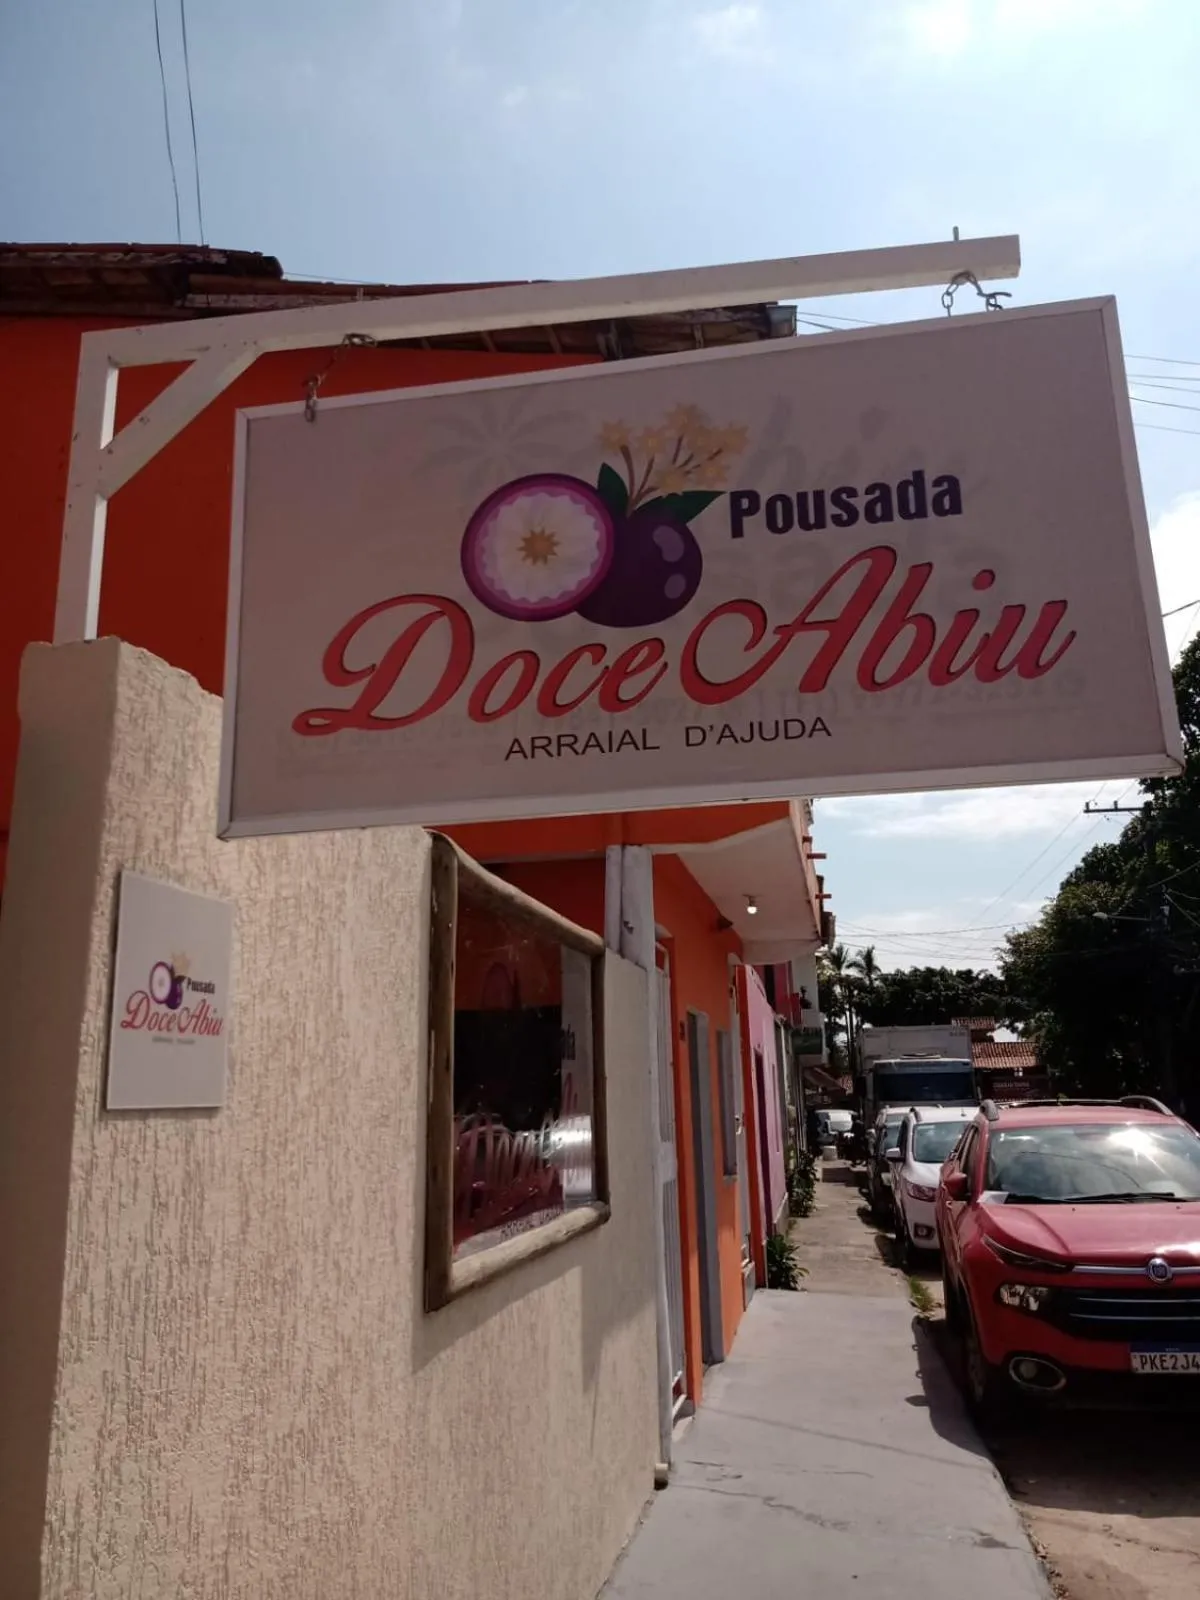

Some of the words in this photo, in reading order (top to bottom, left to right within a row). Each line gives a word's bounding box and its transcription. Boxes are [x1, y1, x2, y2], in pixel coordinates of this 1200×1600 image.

[728, 470, 963, 540] Pousada
[291, 594, 669, 739] Doce
[679, 546, 1078, 706] Abiu
[505, 727, 661, 761] ARRAIAL
[685, 716, 832, 748] D'AJUDA
[120, 990, 178, 1033] Doce
[1139, 1353, 1200, 1371] PKE2J4
